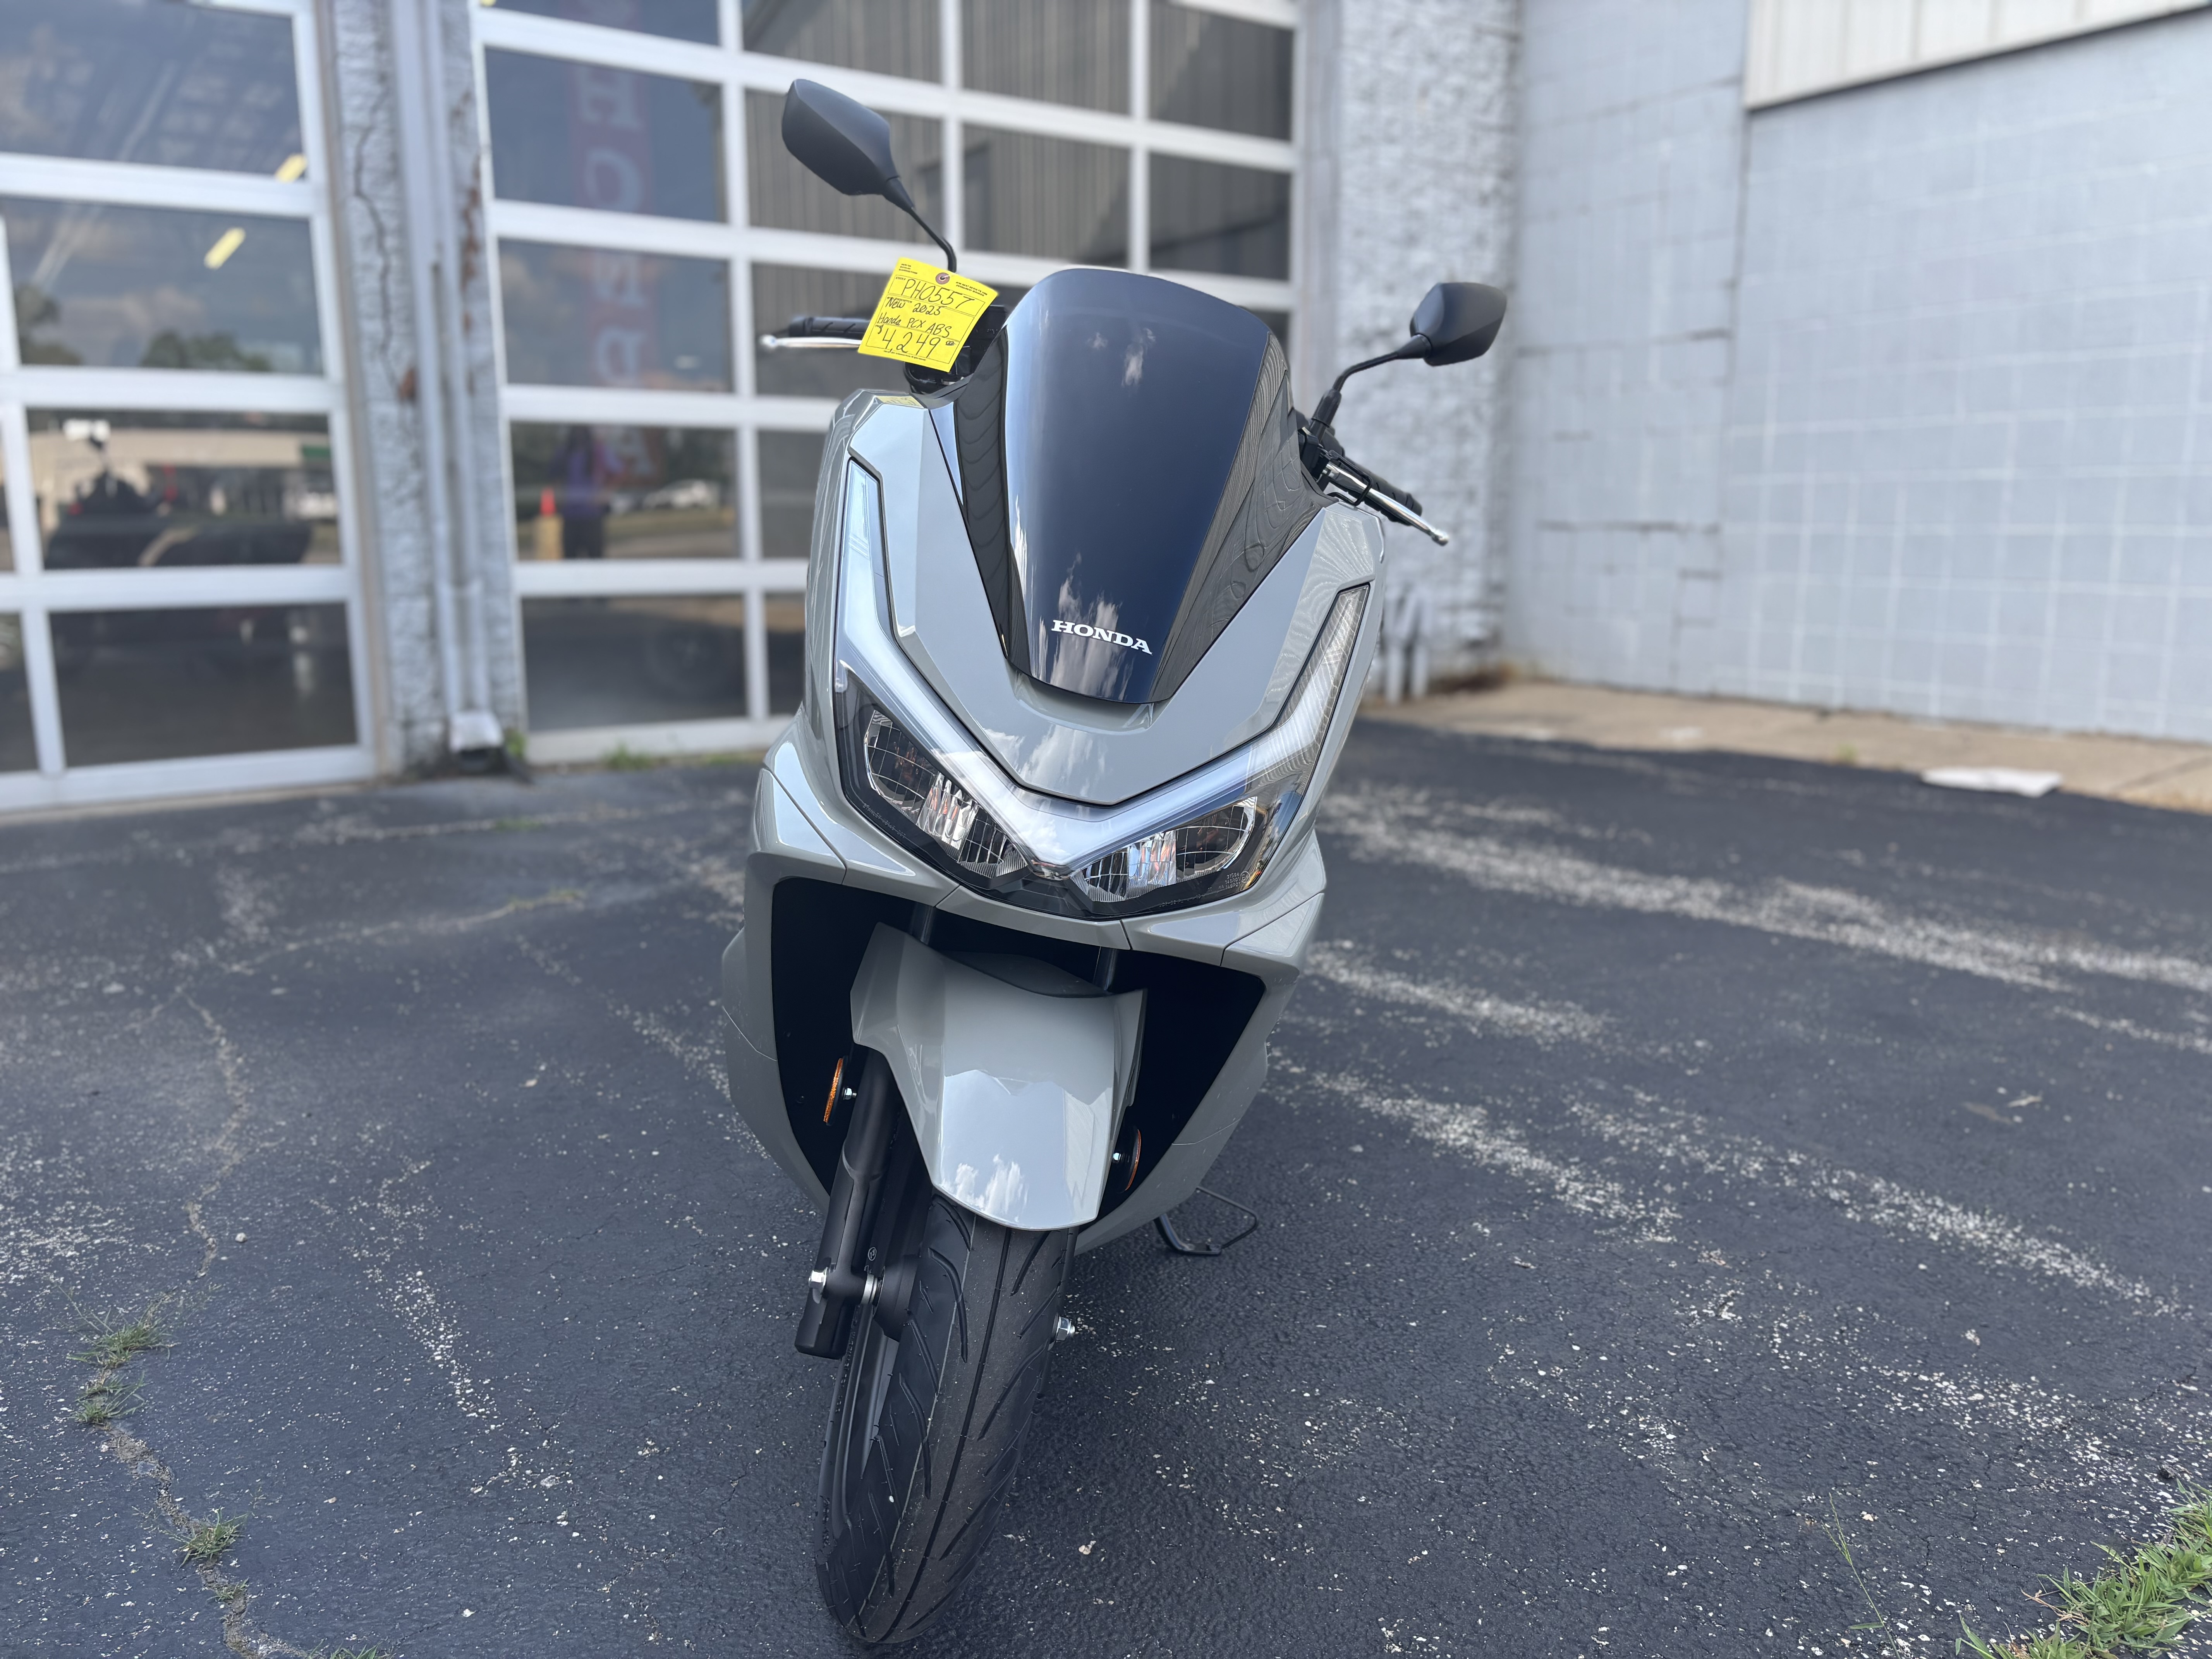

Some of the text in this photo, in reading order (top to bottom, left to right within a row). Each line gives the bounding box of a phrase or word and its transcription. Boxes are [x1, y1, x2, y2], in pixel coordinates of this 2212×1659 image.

[885, 297, 906, 309] New
[912, 302, 948, 316] 2025
[877, 311, 952, 338] Honda PCX ABS
[1051, 620, 1153, 655] HONDA
